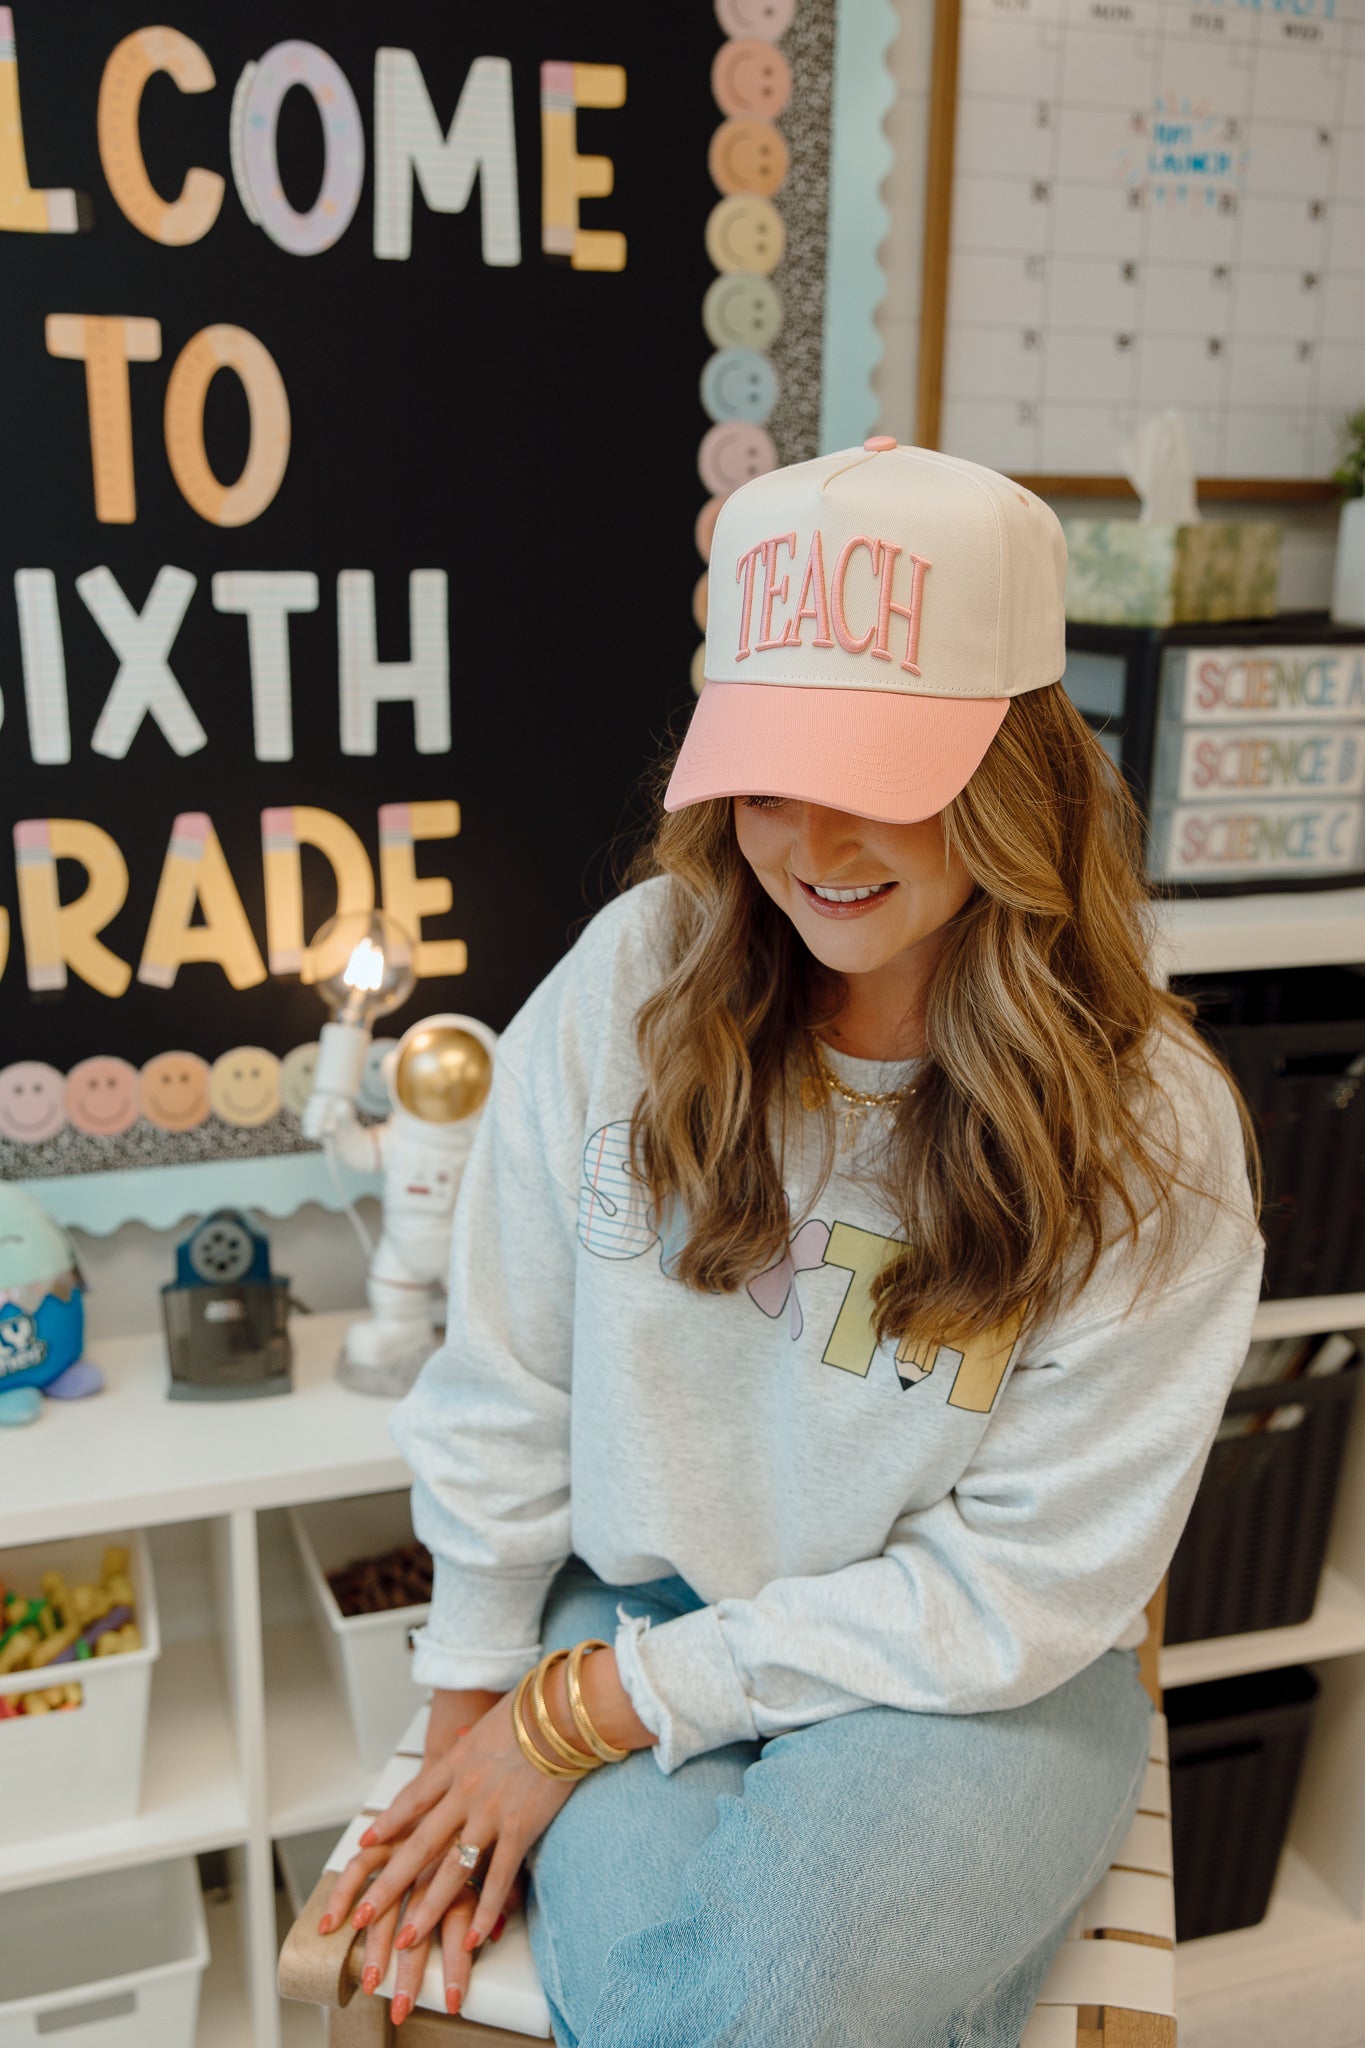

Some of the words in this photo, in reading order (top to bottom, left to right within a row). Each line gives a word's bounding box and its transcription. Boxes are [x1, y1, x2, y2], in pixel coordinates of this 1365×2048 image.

[45, 313, 291, 528] TO
[0, 564, 452, 765] IXTH
[735, 529, 932, 676] TEACH
[1196, 657, 1338, 710] SCIENCE
[1192, 736, 1332, 789] SCIENCE
[1338, 737, 1358, 785] B
[0, 800, 467, 998] RADE
[1181, 814, 1321, 864] SCIENCE
[1327, 811, 1350, 856] C
